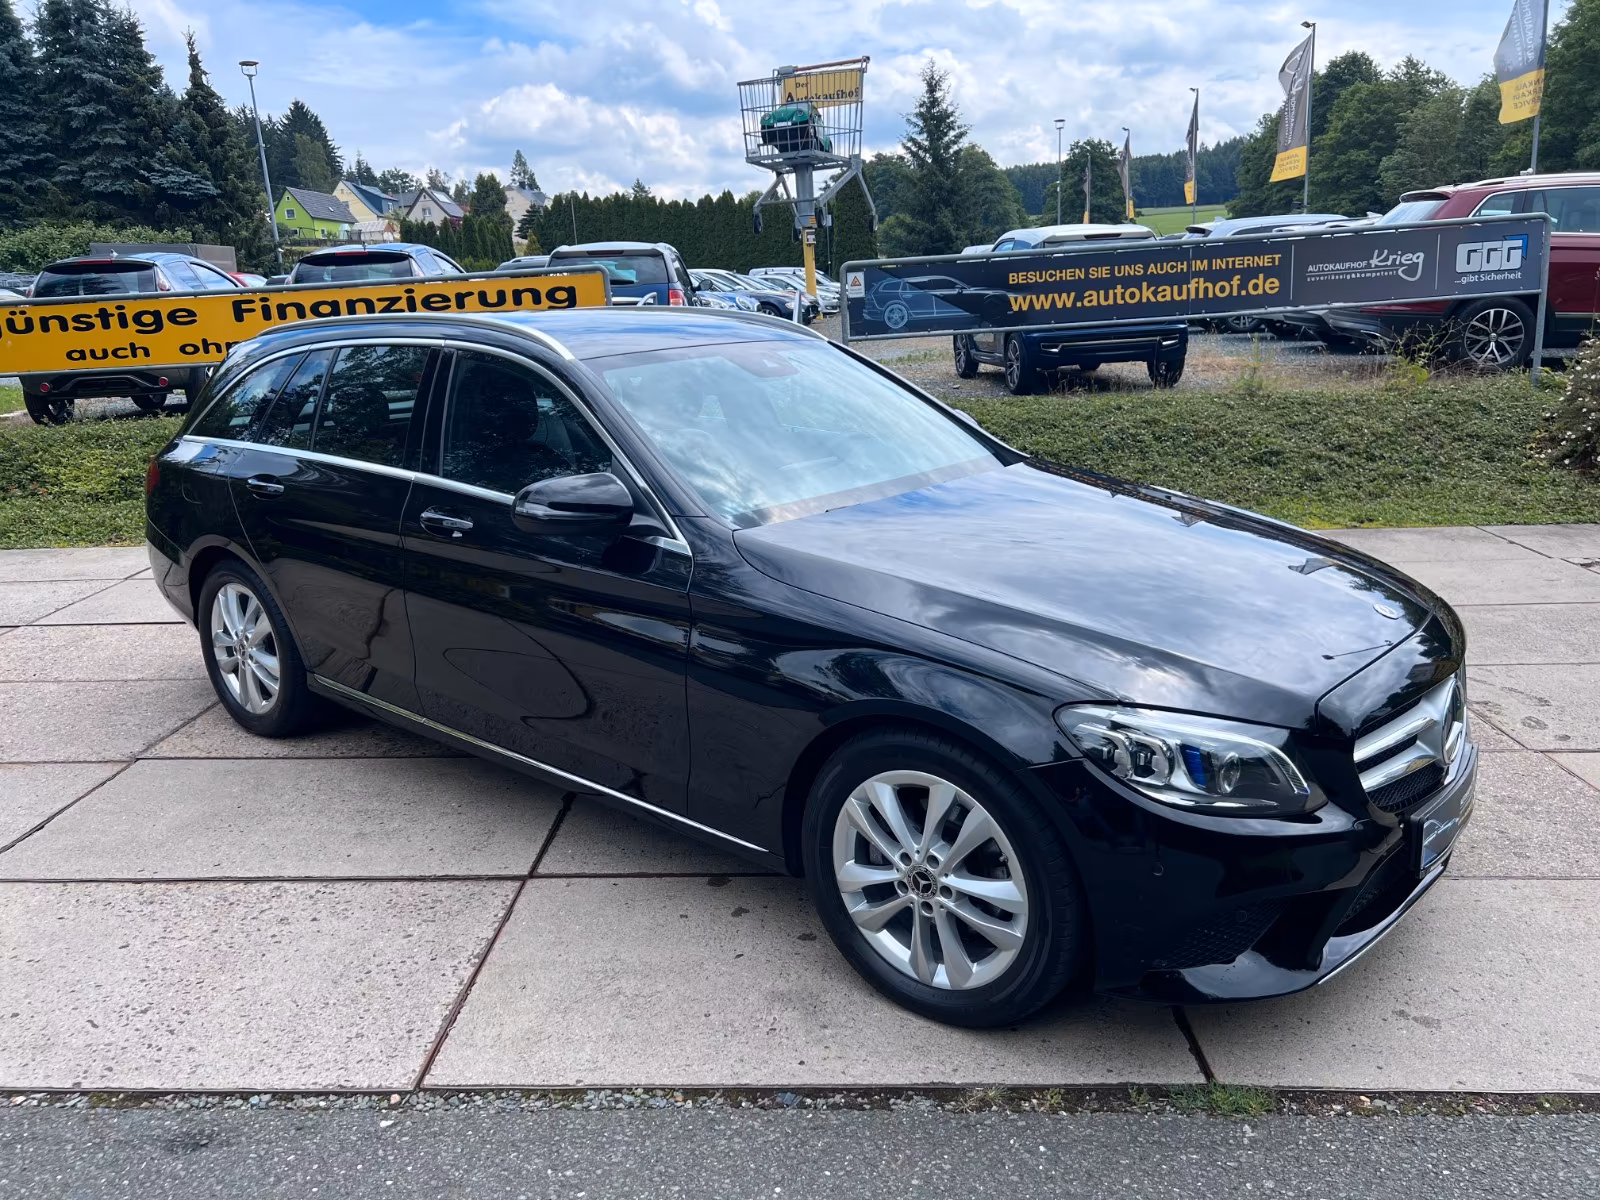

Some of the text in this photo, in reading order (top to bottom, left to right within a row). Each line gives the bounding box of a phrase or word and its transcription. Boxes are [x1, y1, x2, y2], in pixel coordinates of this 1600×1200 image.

[1008, 254, 1282, 285] BESUCHEN SIE UNS AUCH IM INTERNET
[1307, 249, 1425, 282] AUTOKAUFHOF Krieg
[1480, 271, 1522, 282] Sicherheit
[1008, 273, 1281, 312] www.autokaufhof.de
[0, 285, 578, 339] ünstige Finanzierung
[65, 341, 151, 361] auch
